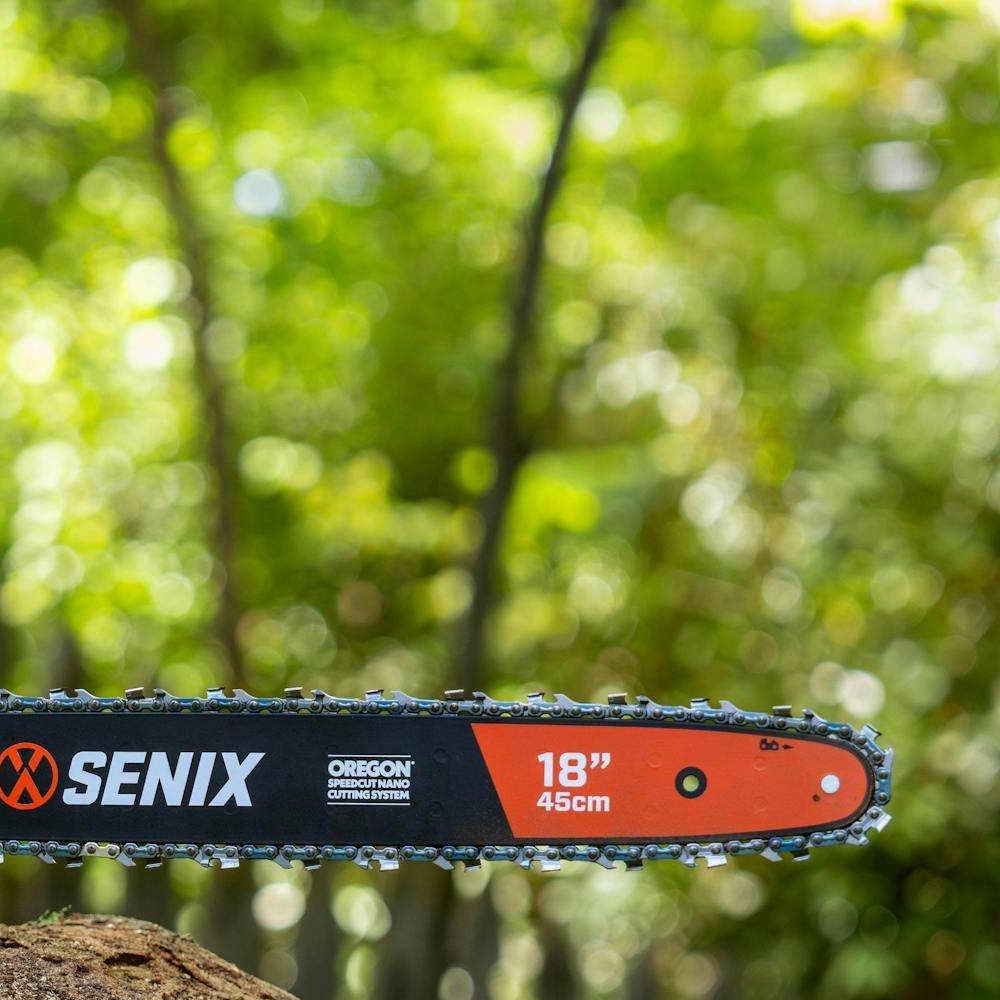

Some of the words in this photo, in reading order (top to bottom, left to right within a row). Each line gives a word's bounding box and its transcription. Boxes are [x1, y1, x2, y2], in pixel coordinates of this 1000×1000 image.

[62, 750, 266, 807] SENIX
[327, 778, 377, 789] SPEEDCUT
[377, 779, 411, 789] NANO
[327, 789, 370, 800] CUTTING
[371, 790, 410, 800] SYSTEM
[537, 791, 611, 812] 45cm
